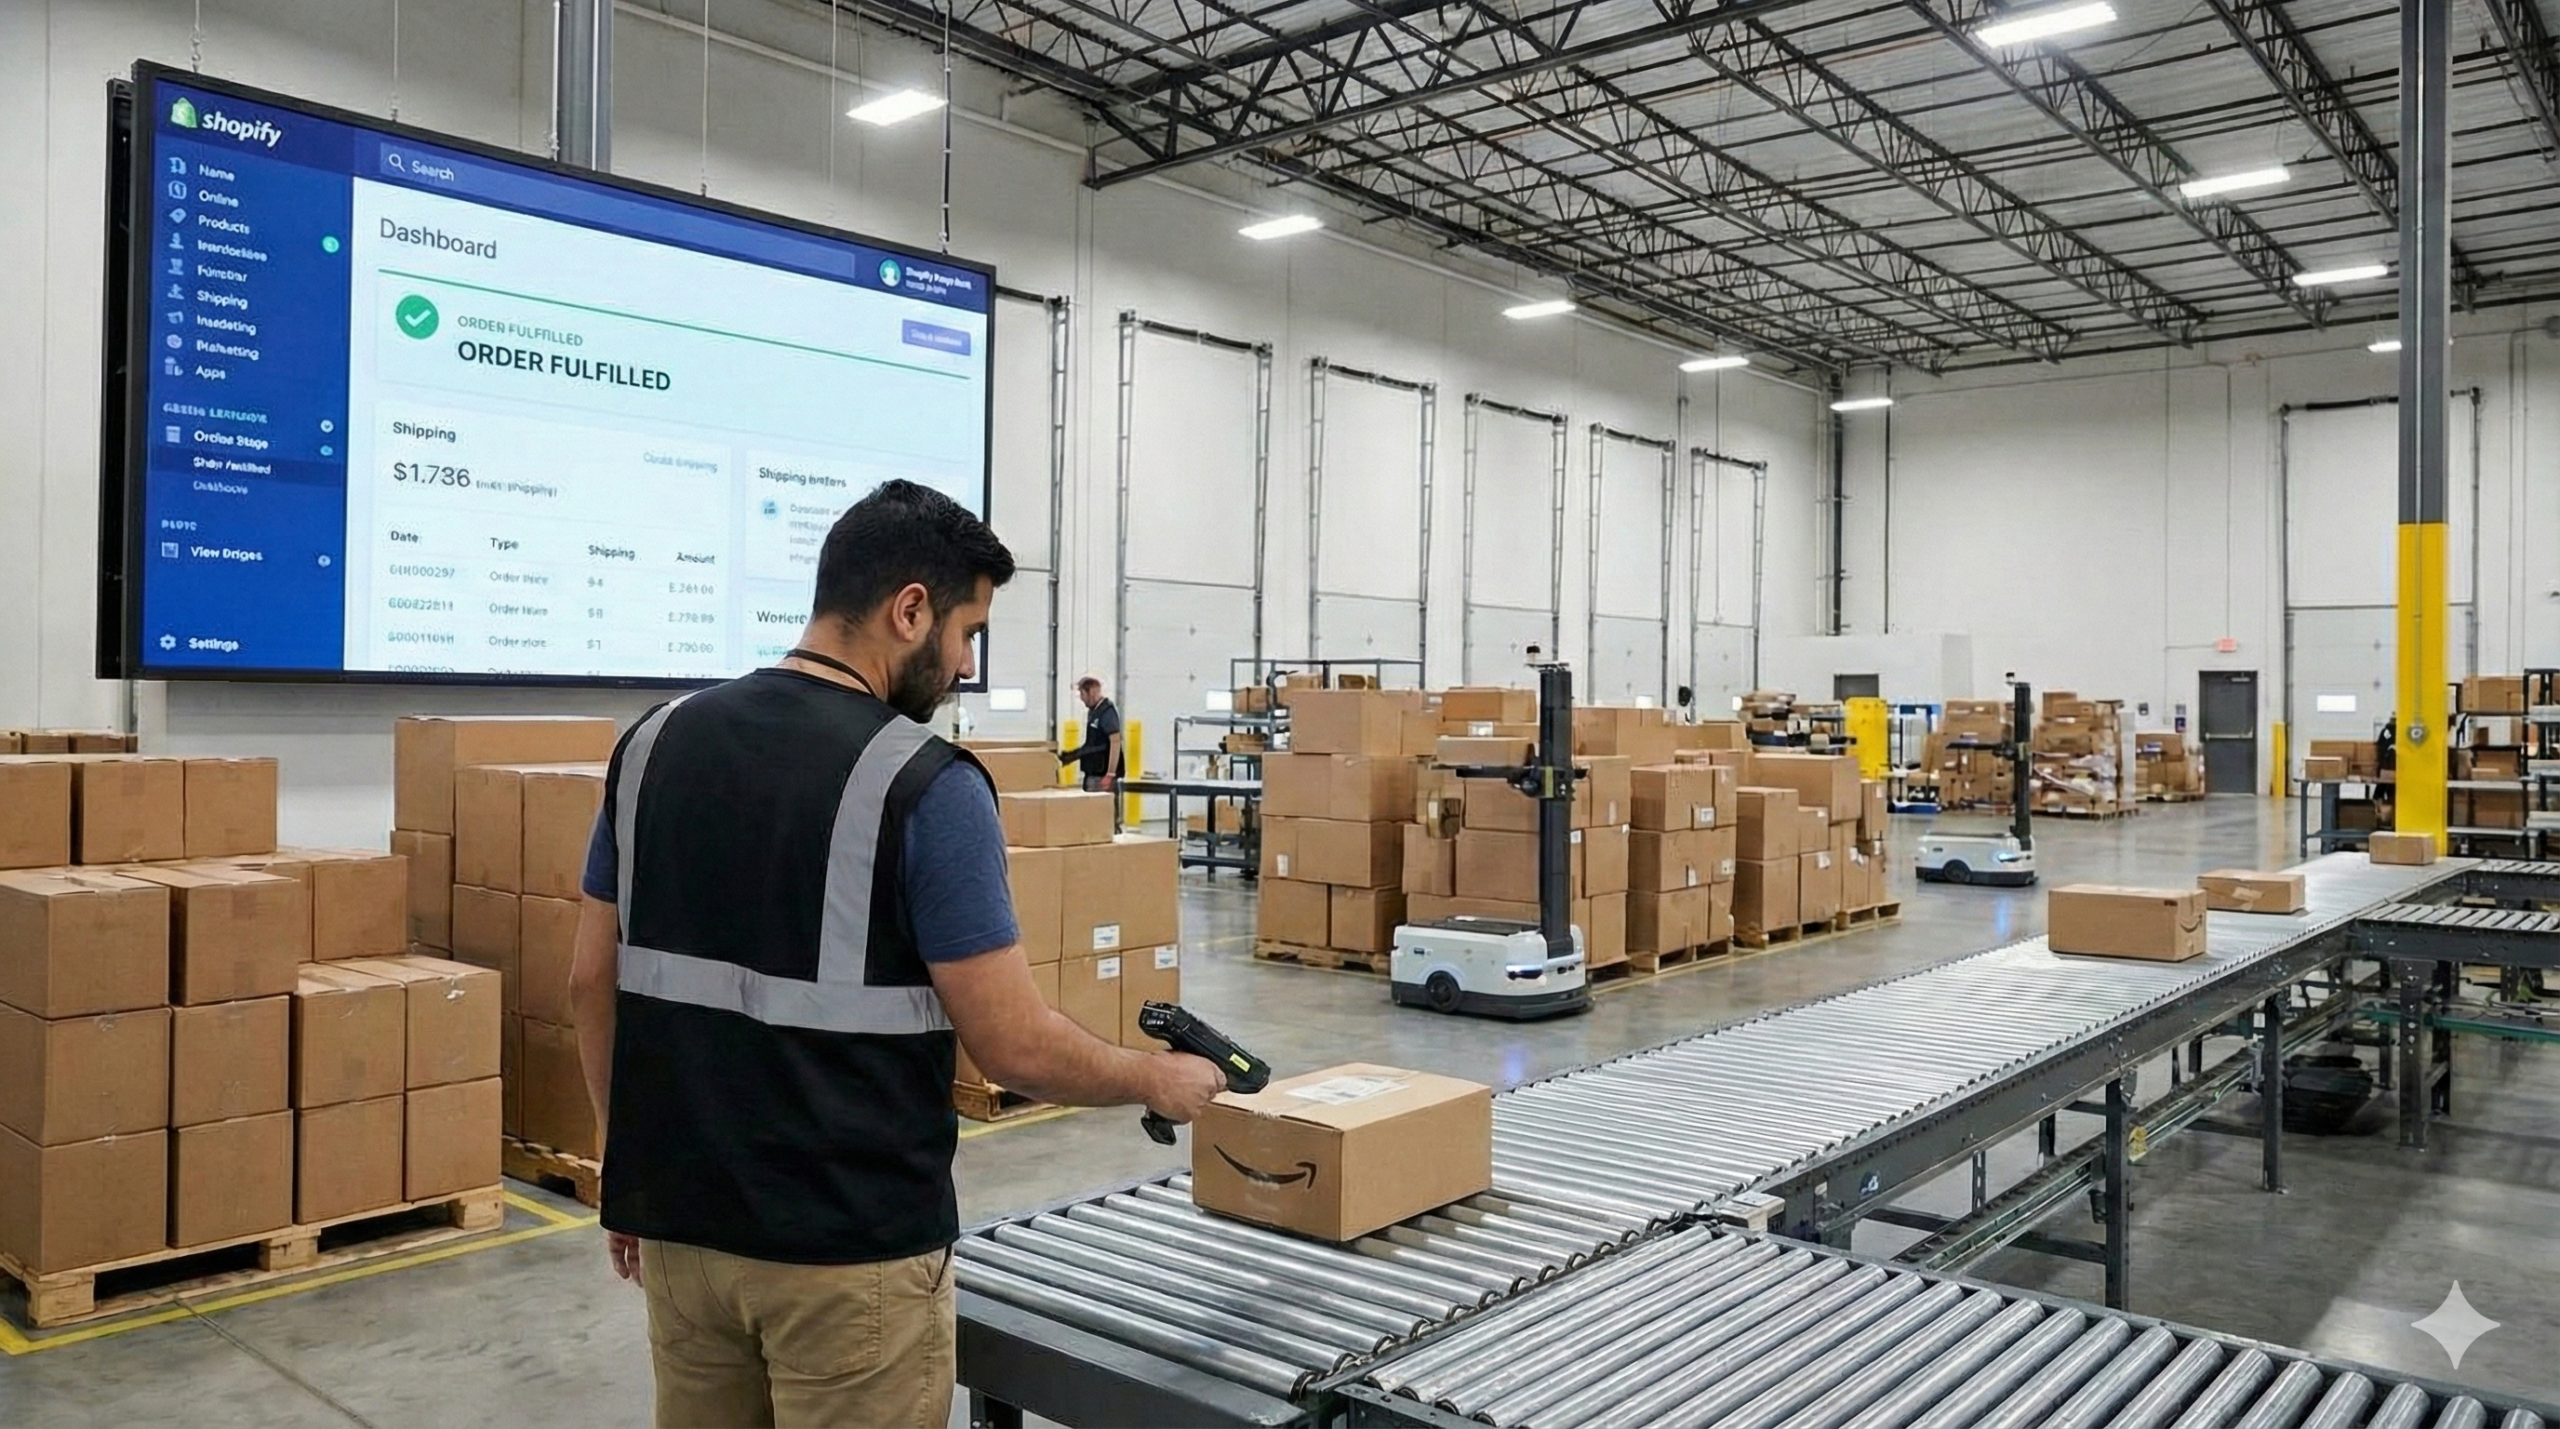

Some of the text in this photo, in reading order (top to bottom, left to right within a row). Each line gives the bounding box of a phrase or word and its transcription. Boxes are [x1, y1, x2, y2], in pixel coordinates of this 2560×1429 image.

[202, 111, 282, 148] shopify
[411, 160, 455, 181] Search
[198, 215, 250, 235] Products
[379, 217, 497, 259] Dashboard
[196, 290, 248, 310] Shipping
[457, 315, 505, 334] ORDER
[195, 365, 226, 380] Apps
[458, 340, 671, 391] ORDER FULFILLED
[393, 421, 457, 443] Shipping
[393, 462, 471, 488] $1.736
[390, 530, 419, 544] Date
[190, 545, 220, 558] View
[188, 637, 239, 652] Settings
